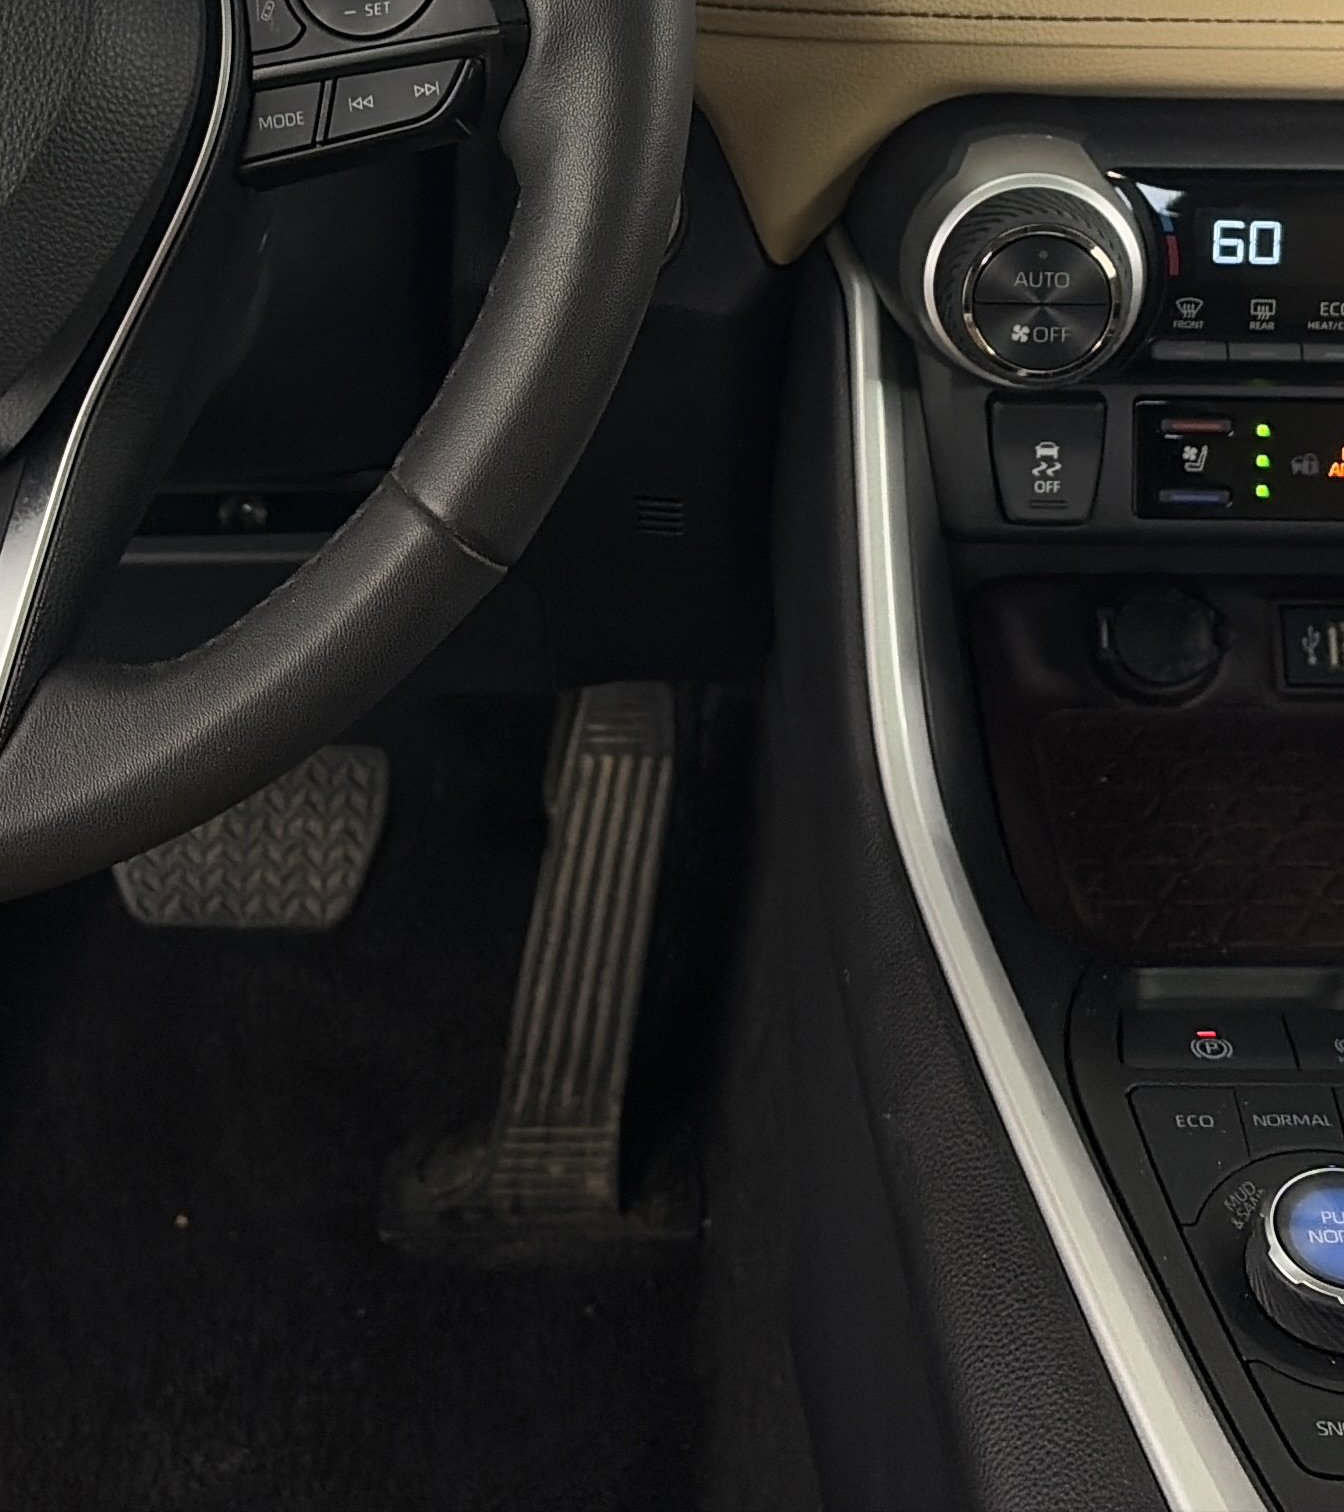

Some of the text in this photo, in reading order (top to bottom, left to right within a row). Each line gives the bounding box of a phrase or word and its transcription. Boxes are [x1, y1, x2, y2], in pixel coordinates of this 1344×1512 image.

[364, 0, 392, 18] SET
[258, 110, 306, 131] MODE
[1212, 218, 1282, 266] 60
[1013, 270, 1071, 289] AUTO
[1172, 319, 1205, 329] FRONT
[1248, 321, 1276, 331] REAR
[1032, 325, 1072, 344] OFF
[1033, 479, 1061, 495] OFF
[1174, 1113, 1215, 1129] ECO
[1252, 1113, 1335, 1129] NORMAL
[1223, 1180, 1257, 1212] MUD
